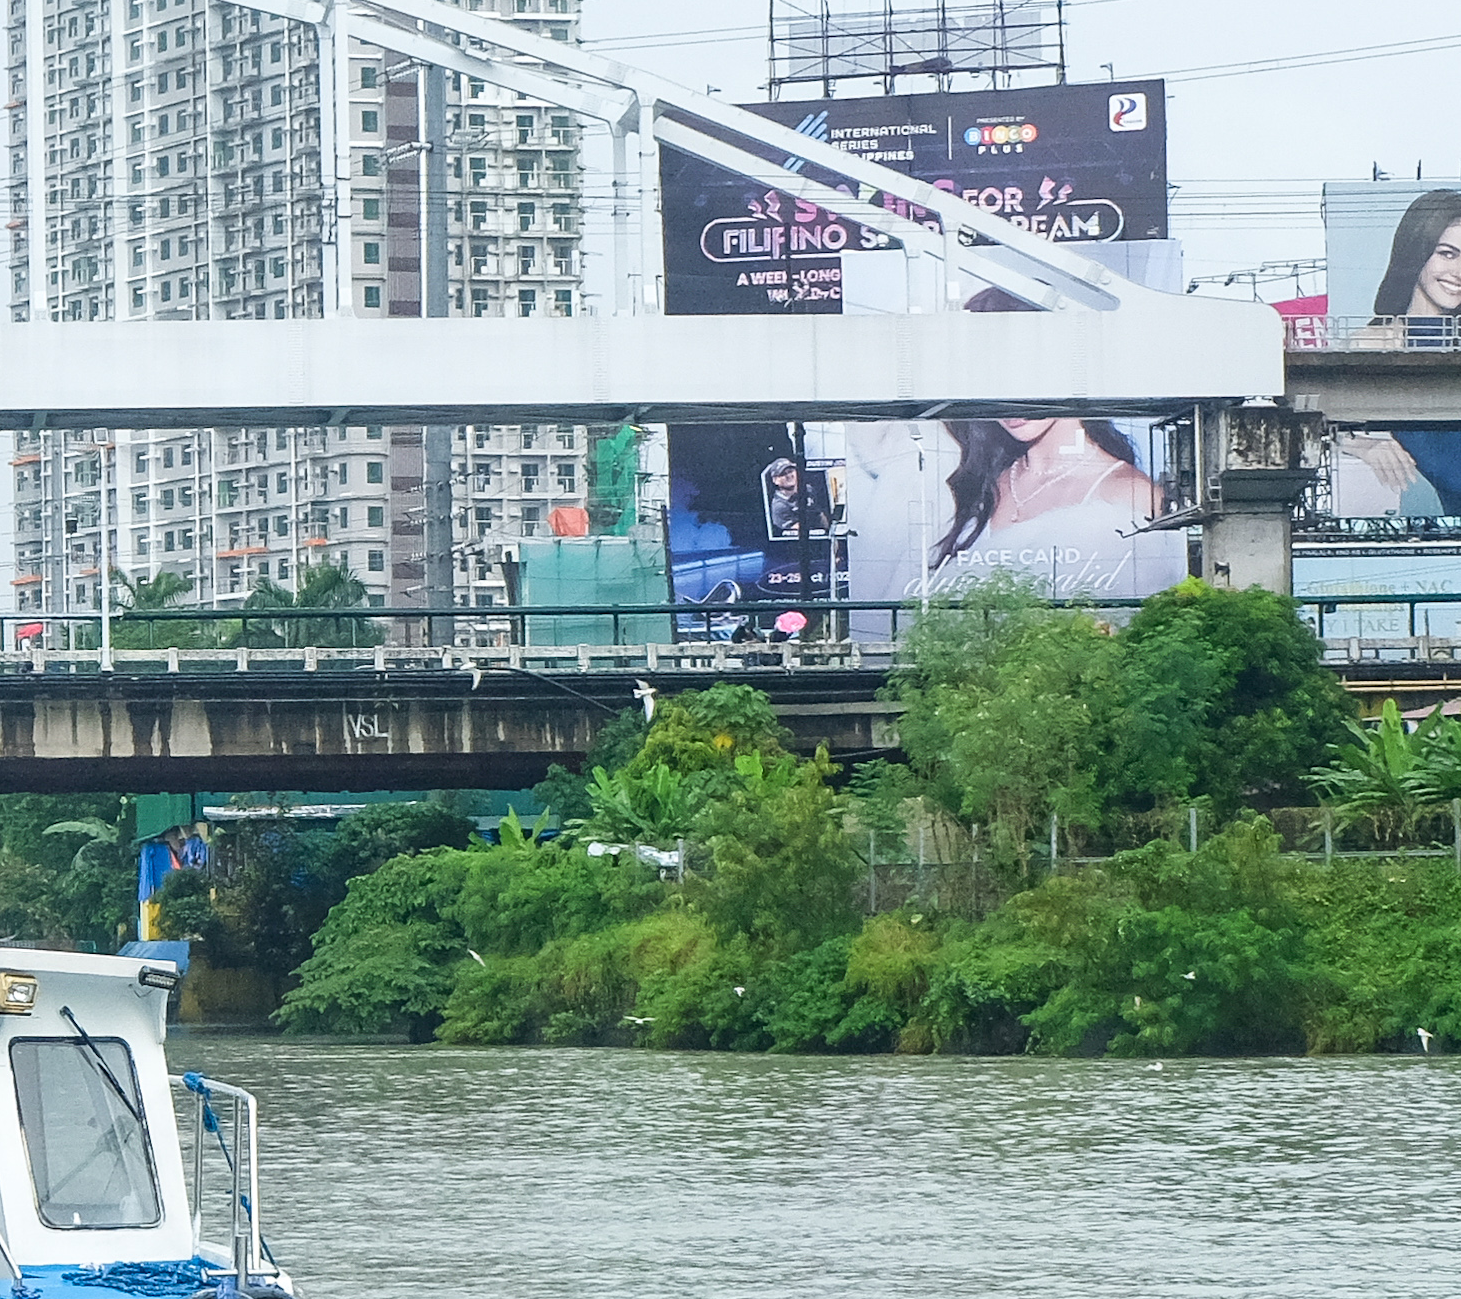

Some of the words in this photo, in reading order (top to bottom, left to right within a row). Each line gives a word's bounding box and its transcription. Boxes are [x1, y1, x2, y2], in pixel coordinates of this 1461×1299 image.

[830, 123, 938, 140] INTERNATIONAL
[965, 126, 1036, 144] BINGO
[830, 139, 879, 151] SERIES
[977, 143, 1023, 155] PLUS
[736, 272, 749, 287] A
[956, 548, 1014, 567] FACE
[1018, 547, 1081, 565] CARD
